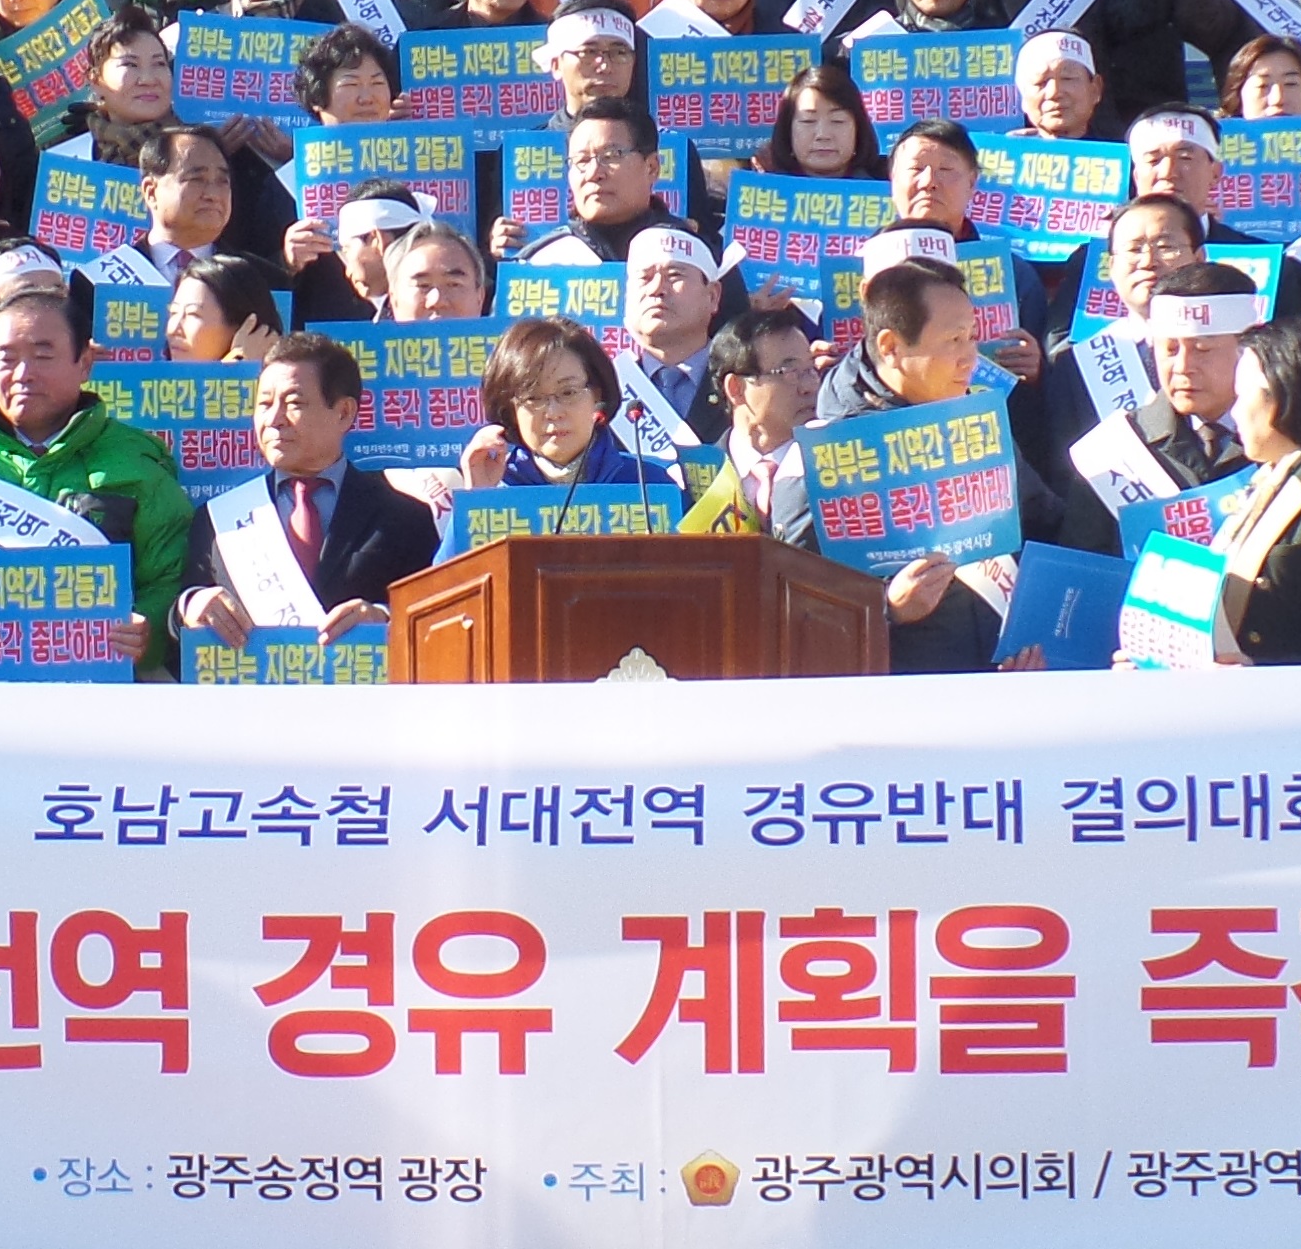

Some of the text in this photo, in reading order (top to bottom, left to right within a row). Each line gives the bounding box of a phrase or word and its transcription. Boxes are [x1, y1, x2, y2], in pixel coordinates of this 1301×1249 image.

[411, 43, 509, 79] 정부는 지역간
[861, 44, 1013, 83] 정부는 지역간 갈등과
[1020, 156, 1122, 192] 지역간 갈등과
[660, 236, 693, 257] 반대
[507, 277, 619, 316] 정부는 지역간
[813, 411, 1002, 489] 정부는 지역간 갈등과
[54, 565, 117, 608] 갈등과
[34, 781, 392, 848] 호남고속철
[422, 781, 705, 846] 서대전역
[742, 777, 1024, 846] 경유반대
[252, 905, 553, 1077] 경유
[614, 903, 1076, 1077] 계획을
[165, 1154, 384, 1203] 광주송정역
[398, 1156, 487, 1203] 광장
[751, 1150, 1076, 1202] 광주광역시의회
